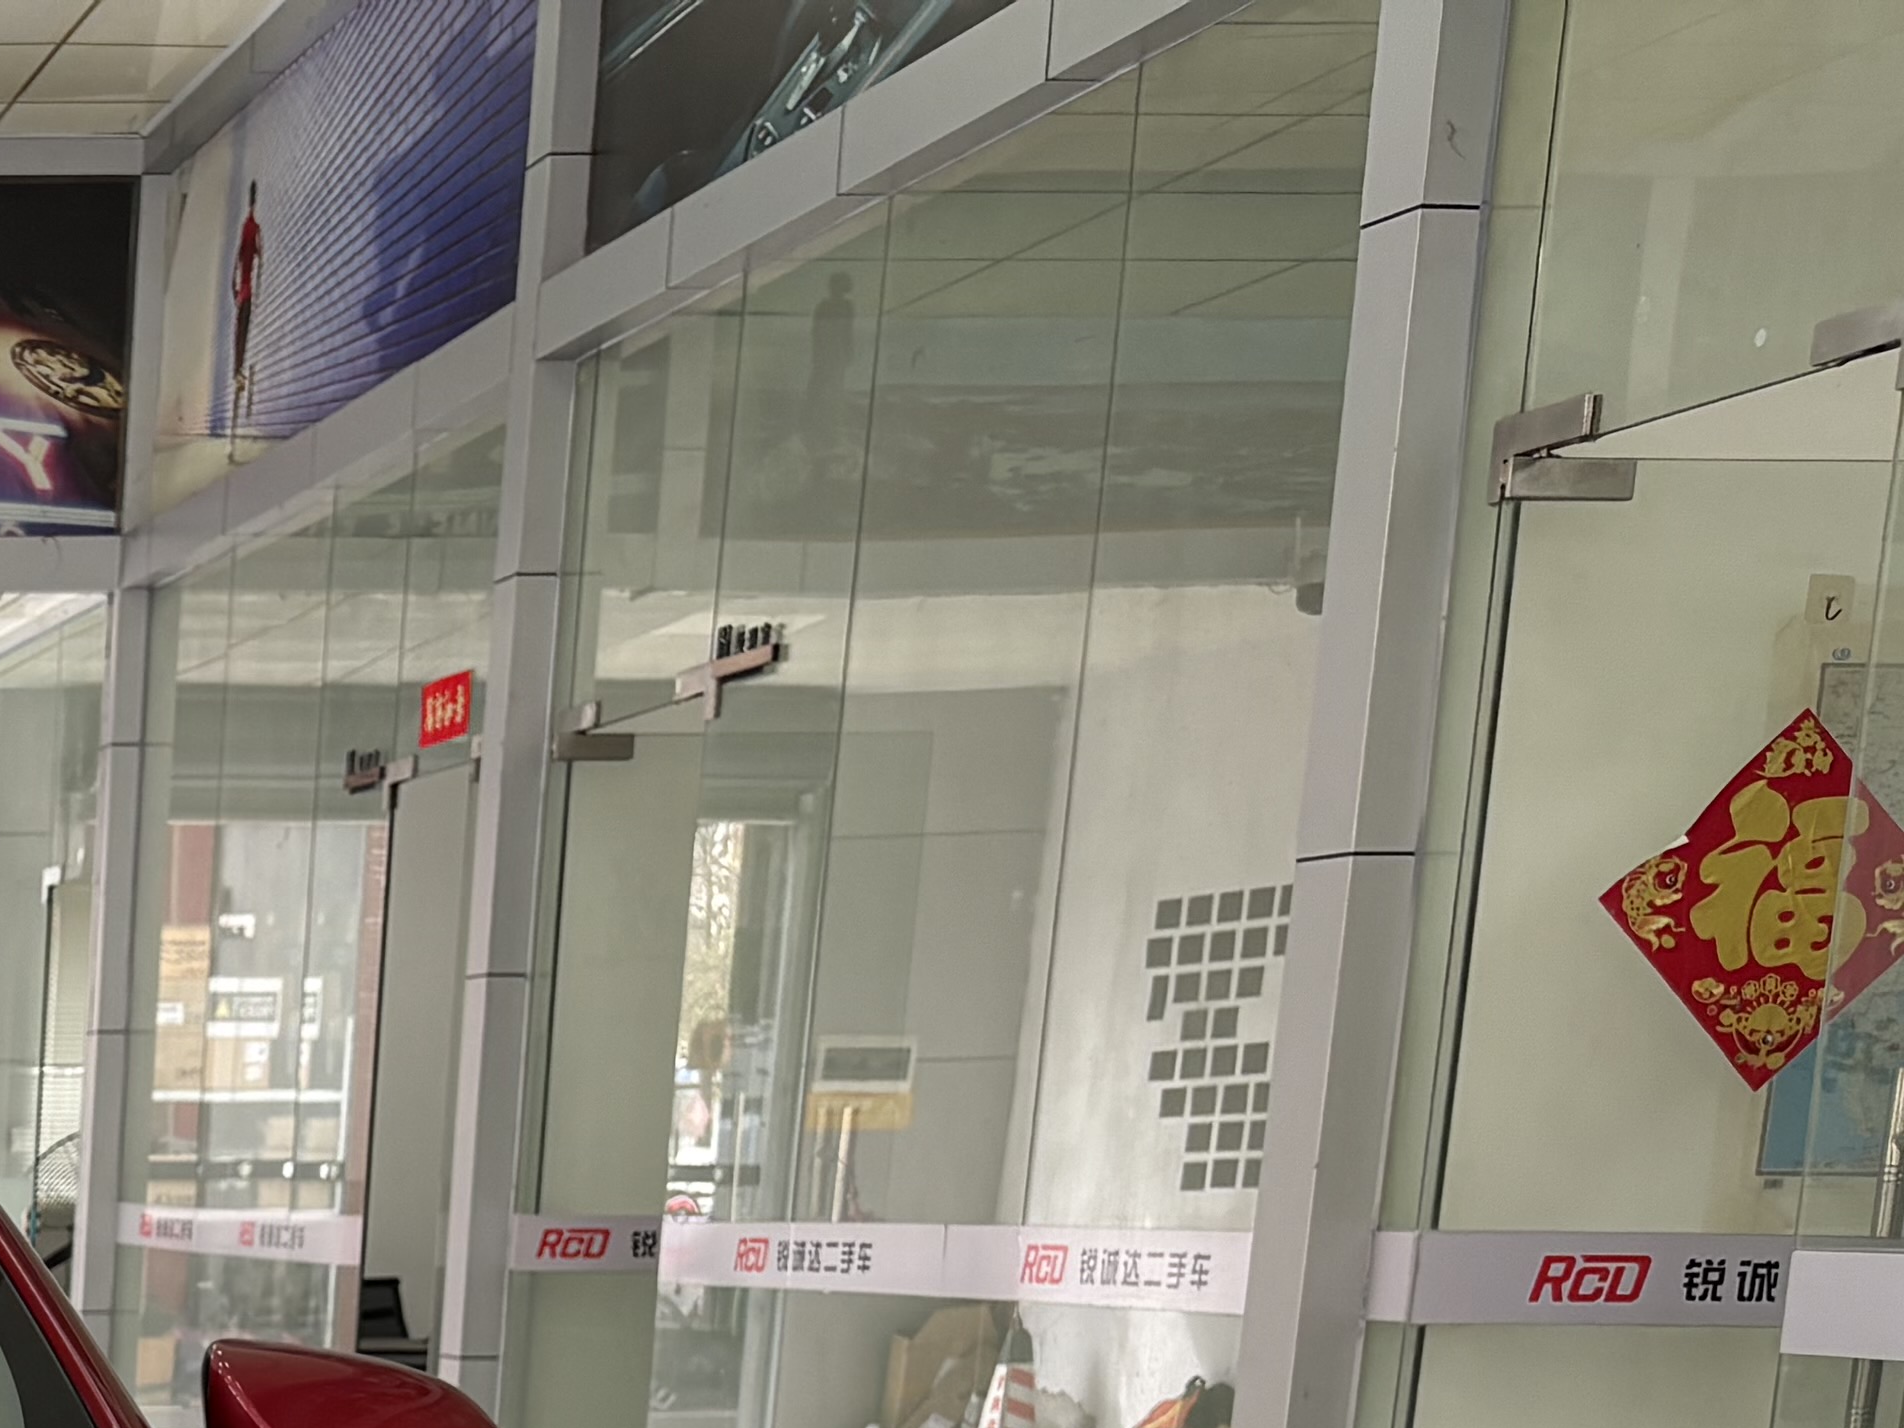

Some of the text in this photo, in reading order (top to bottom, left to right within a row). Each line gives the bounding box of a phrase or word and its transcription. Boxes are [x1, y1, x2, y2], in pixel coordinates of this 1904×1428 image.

[1690, 779, 1870, 981] 福
[537, 1228, 611, 1259] RCD
[1020, 1244, 1211, 1291] RCD 锐诚达二手车
[1528, 1254, 1780, 1304] RCD 锐诚
